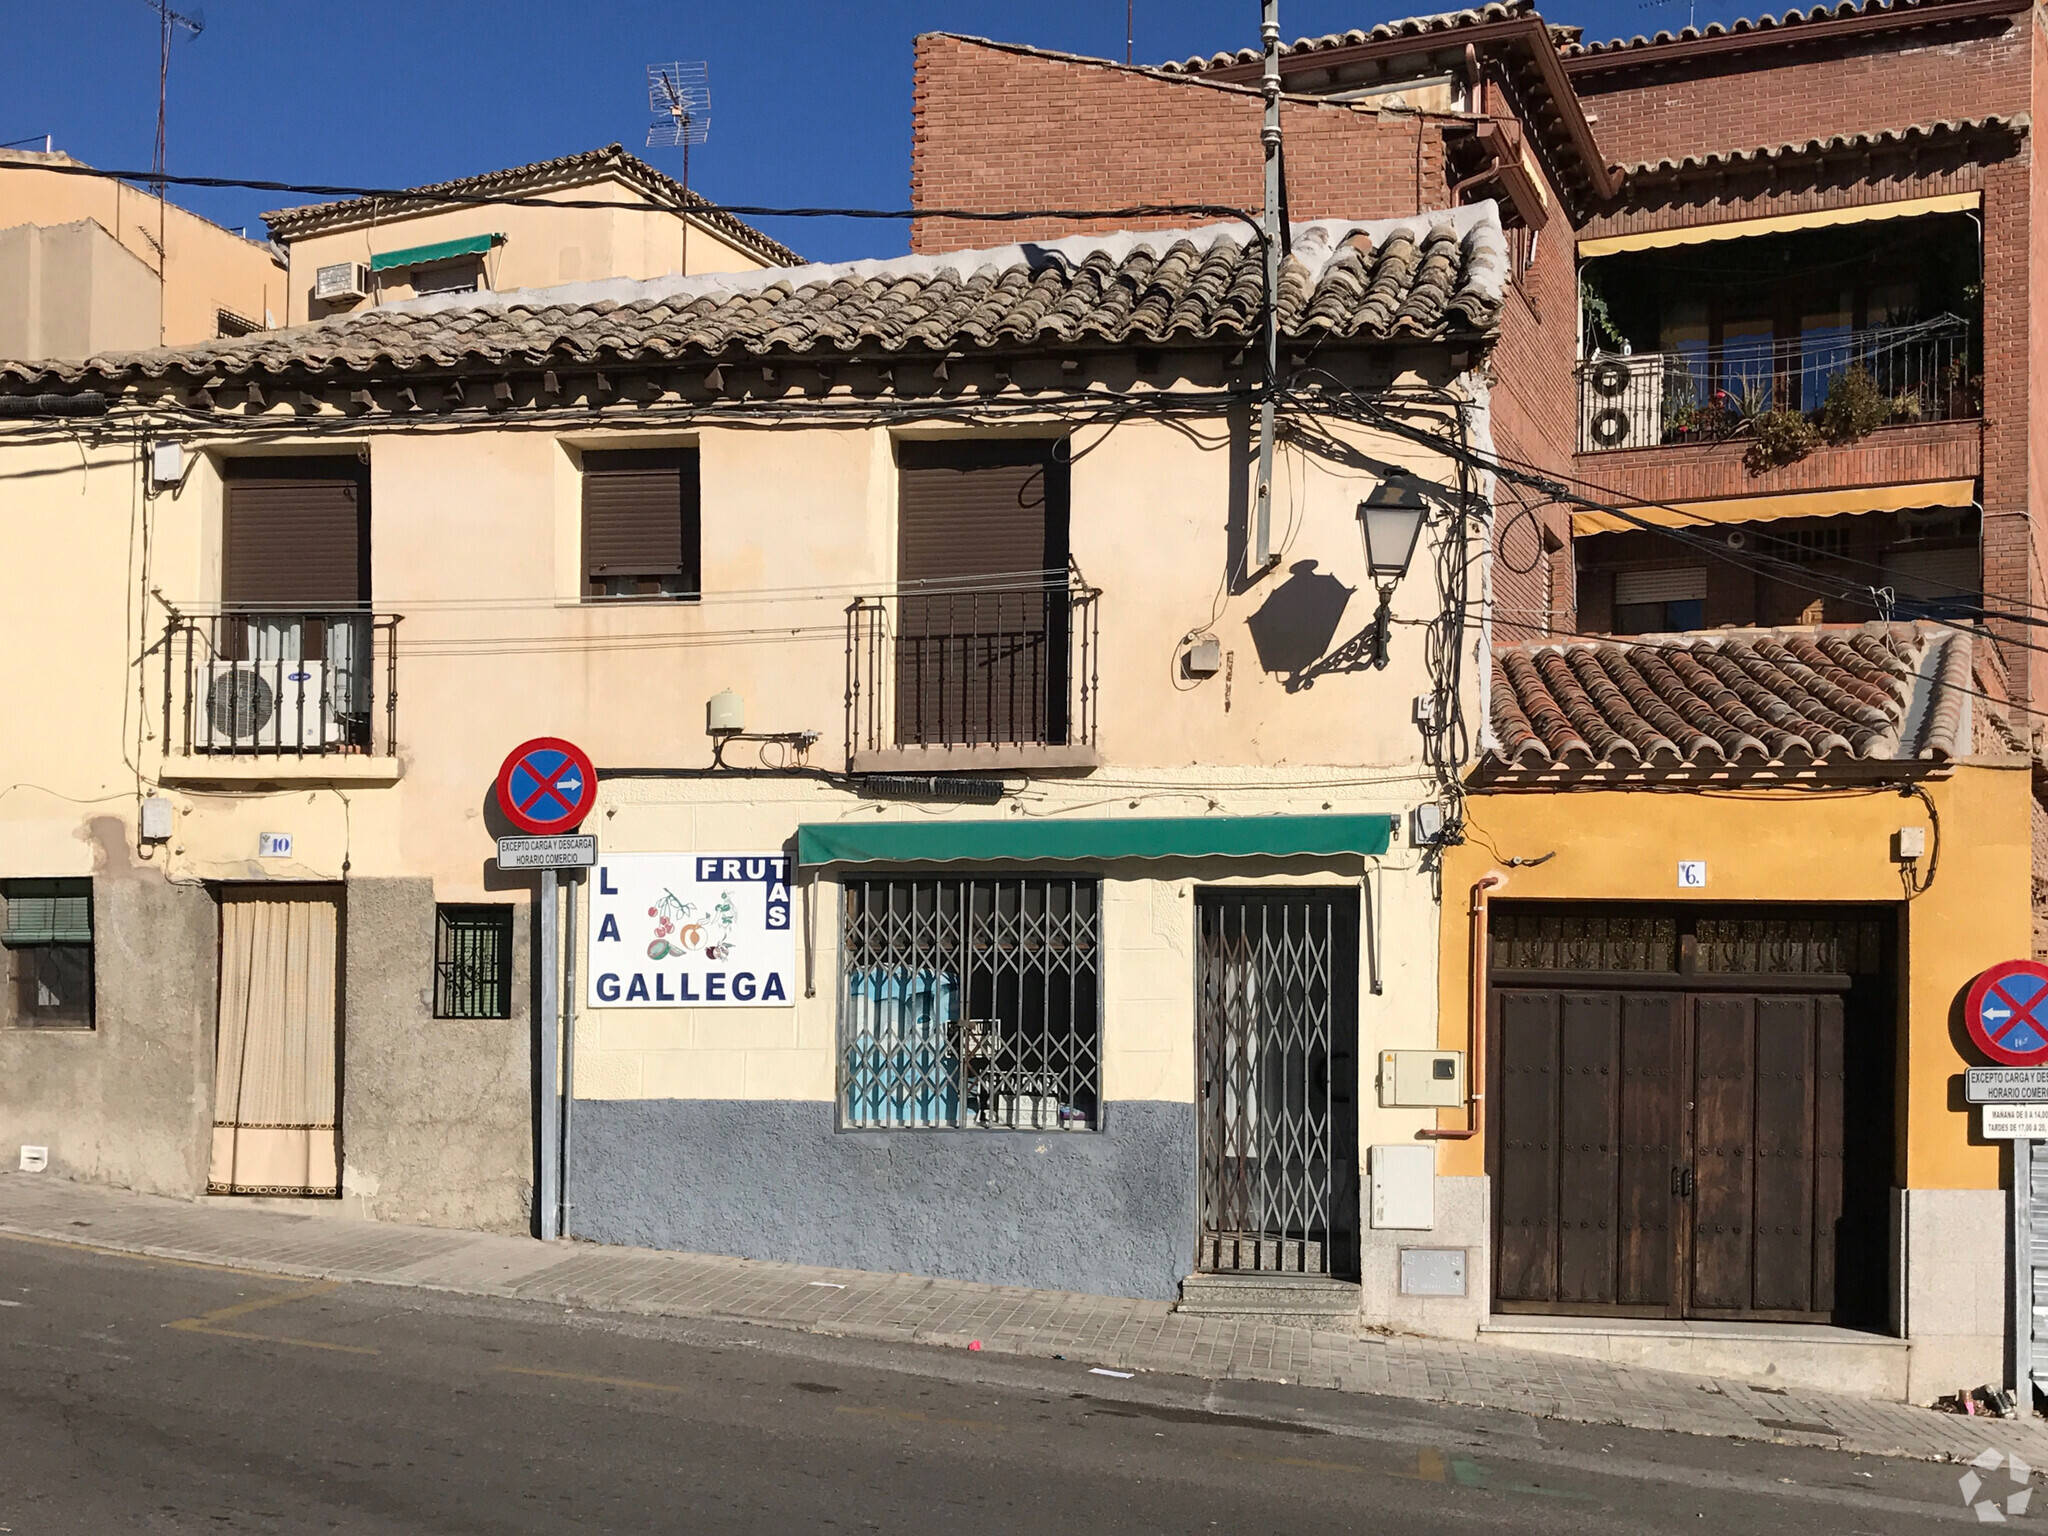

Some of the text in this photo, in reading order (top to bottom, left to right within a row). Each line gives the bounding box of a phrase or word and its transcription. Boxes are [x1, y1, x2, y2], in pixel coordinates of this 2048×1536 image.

[272, 838, 290, 853] 10
[501, 838, 592, 852] EXCEPTO CARGA Y DESCARGA
[516, 853, 578, 865] HORARIO COMERCIO
[597, 866, 621, 942] LA
[596, 971, 787, 1002] GALLEGA
[1971, 1072, 2003, 1083] EXCEPTO
[2004, 1072, 2029, 1083] CARGA
[2030, 1072, 2035, 1083] Y
[1988, 1087, 2020, 1098] HORARIO
[1992, 1109, 2015, 1119] MAÑANA
[2016, 1110, 2023, 1119] DE
[1988, 1123, 2008, 1132] TARDES
[2009, 1123, 2017, 1132] DE
